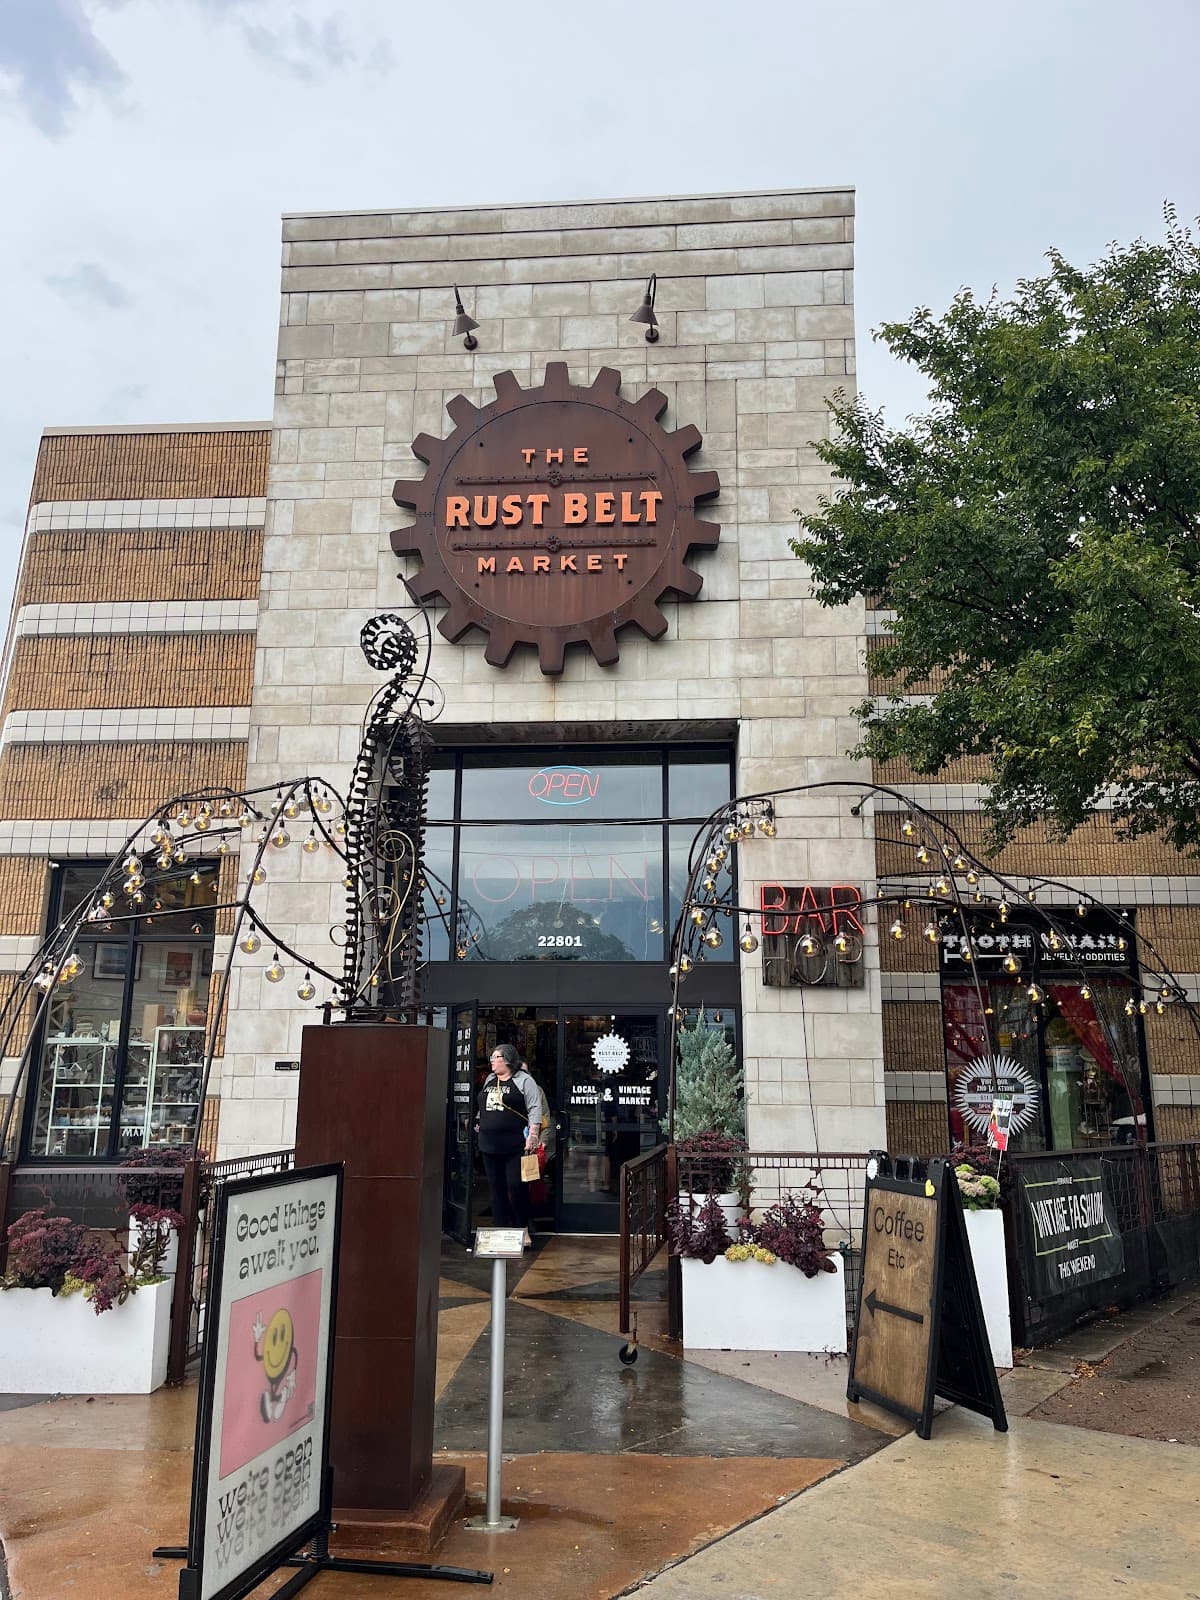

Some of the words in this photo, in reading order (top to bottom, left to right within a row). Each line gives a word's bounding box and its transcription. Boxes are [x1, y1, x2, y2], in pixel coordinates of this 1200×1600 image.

[521, 447, 589, 464] THE
[445, 494, 550, 528] RUST
[563, 491, 664, 526] BELT
[477, 553, 629, 574] MARKET
[528, 773, 600, 797] OPEN
[473, 854, 649, 903] OPEN
[760, 883, 865, 936] BAR
[537, 935, 583, 947] 22801
[943, 933, 1032, 949] TOOTH
[1085, 952, 1126, 961] ODDITIES
[570, 1096, 598, 1105] ARTIST
[618, 1096, 651, 1105] MARKET
[572, 1085, 597, 1094] LOCAL
[603, 1088, 614, 1102] &
[618, 1085, 652, 1094] VINTAGE
[236, 1206, 280, 1242] Good
[283, 1199, 326, 1231] things
[874, 1206, 925, 1242] Coffee
[239, 1239, 285, 1280] await
[289, 1235, 320, 1271] you.
[888, 1247, 906, 1269] Etc
[274, 1436, 313, 1481] open
